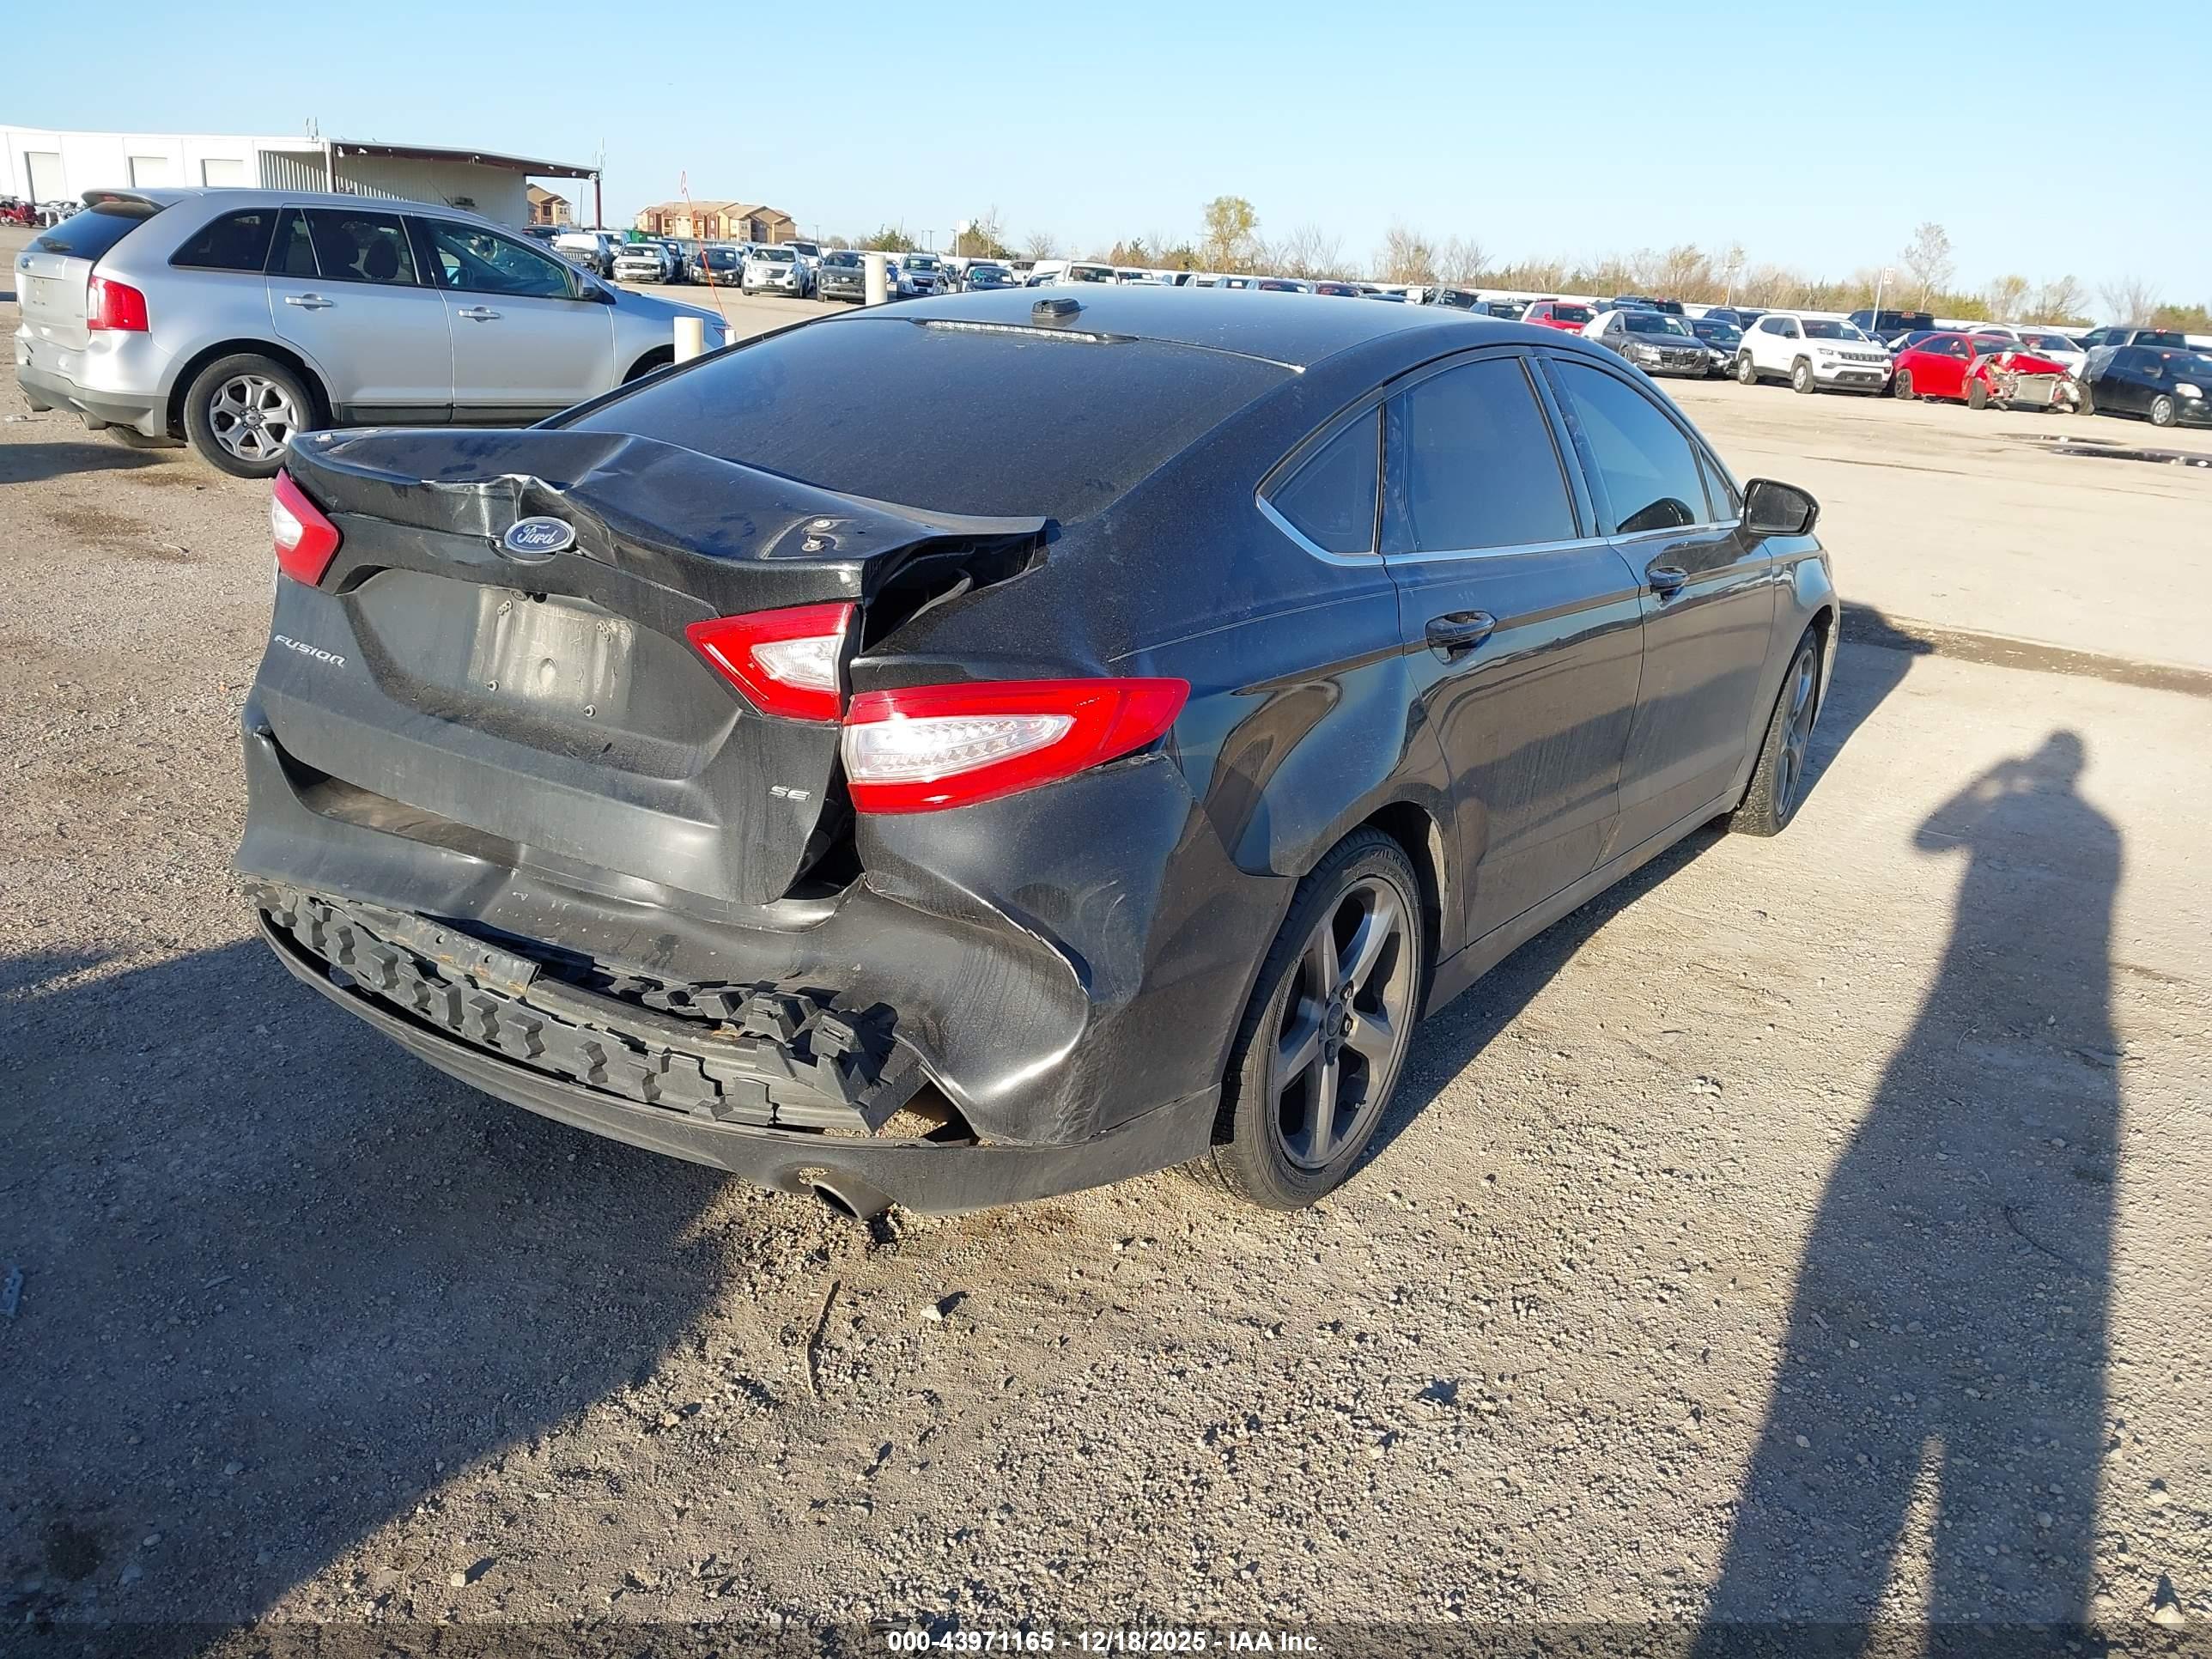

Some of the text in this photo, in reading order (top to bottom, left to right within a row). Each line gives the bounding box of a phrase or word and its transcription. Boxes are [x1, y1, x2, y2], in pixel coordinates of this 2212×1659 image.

[517, 524, 558, 544] Ford
[274, 635, 346, 668] FUSION
[769, 785, 811, 801] SE
